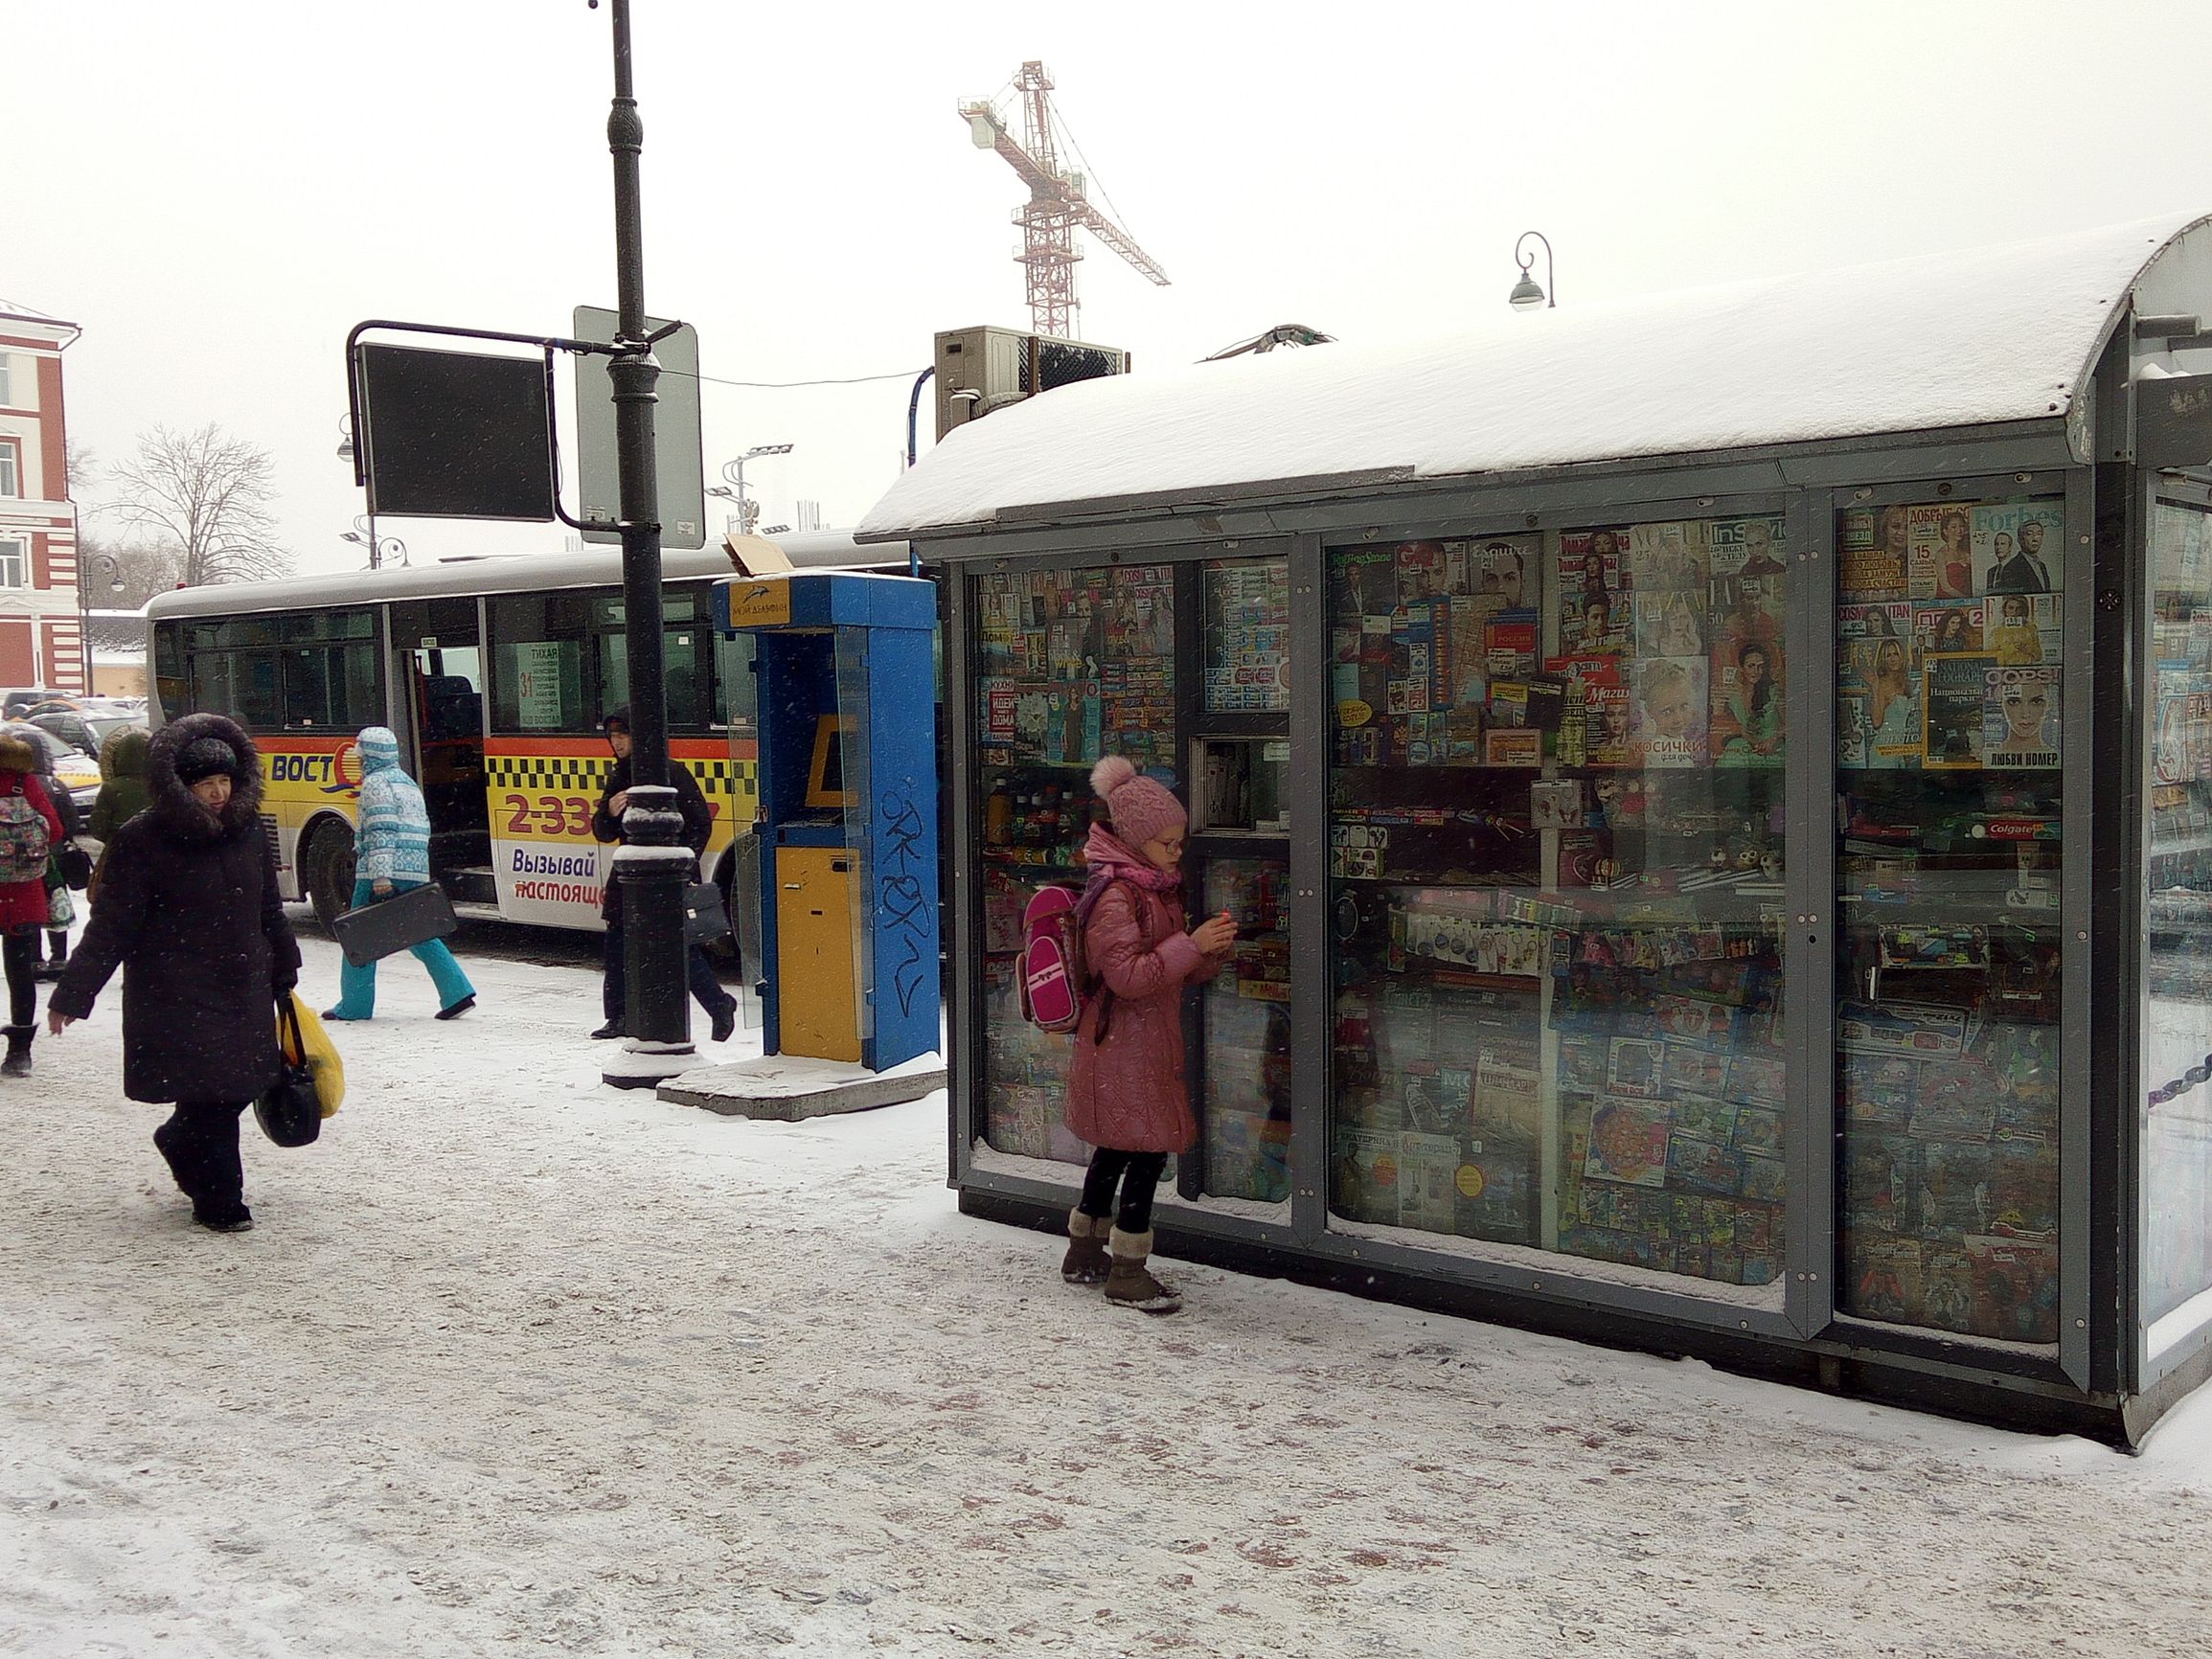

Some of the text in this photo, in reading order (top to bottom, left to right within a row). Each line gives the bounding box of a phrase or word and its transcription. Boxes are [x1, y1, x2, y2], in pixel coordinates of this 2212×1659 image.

[1973, 506, 2064, 533] Forbes
[1713, 520, 1787, 544] InSyl
[1471, 544, 1533, 560] Esquire
[1914, 544, 1930, 559] 15
[1873, 578, 1907, 587] СЧАСТЛИ
[1838, 604, 1910, 621] COSMITAN
[1938, 661, 1983, 674] NATIONA
[520, 671, 533, 697] 31
[1930, 671, 1983, 684] GEOGRAPH
[1985, 669, 2059, 686] OOPS!
[992, 714, 1015, 726] ДОМА
[1634, 740, 1702, 753] КОСИЧКИ
[1991, 752, 2059, 766] ЛЮБВИ НОМЕР
[1990, 823, 2033, 835] Colgate
[513, 848, 594, 877] Вызывай
